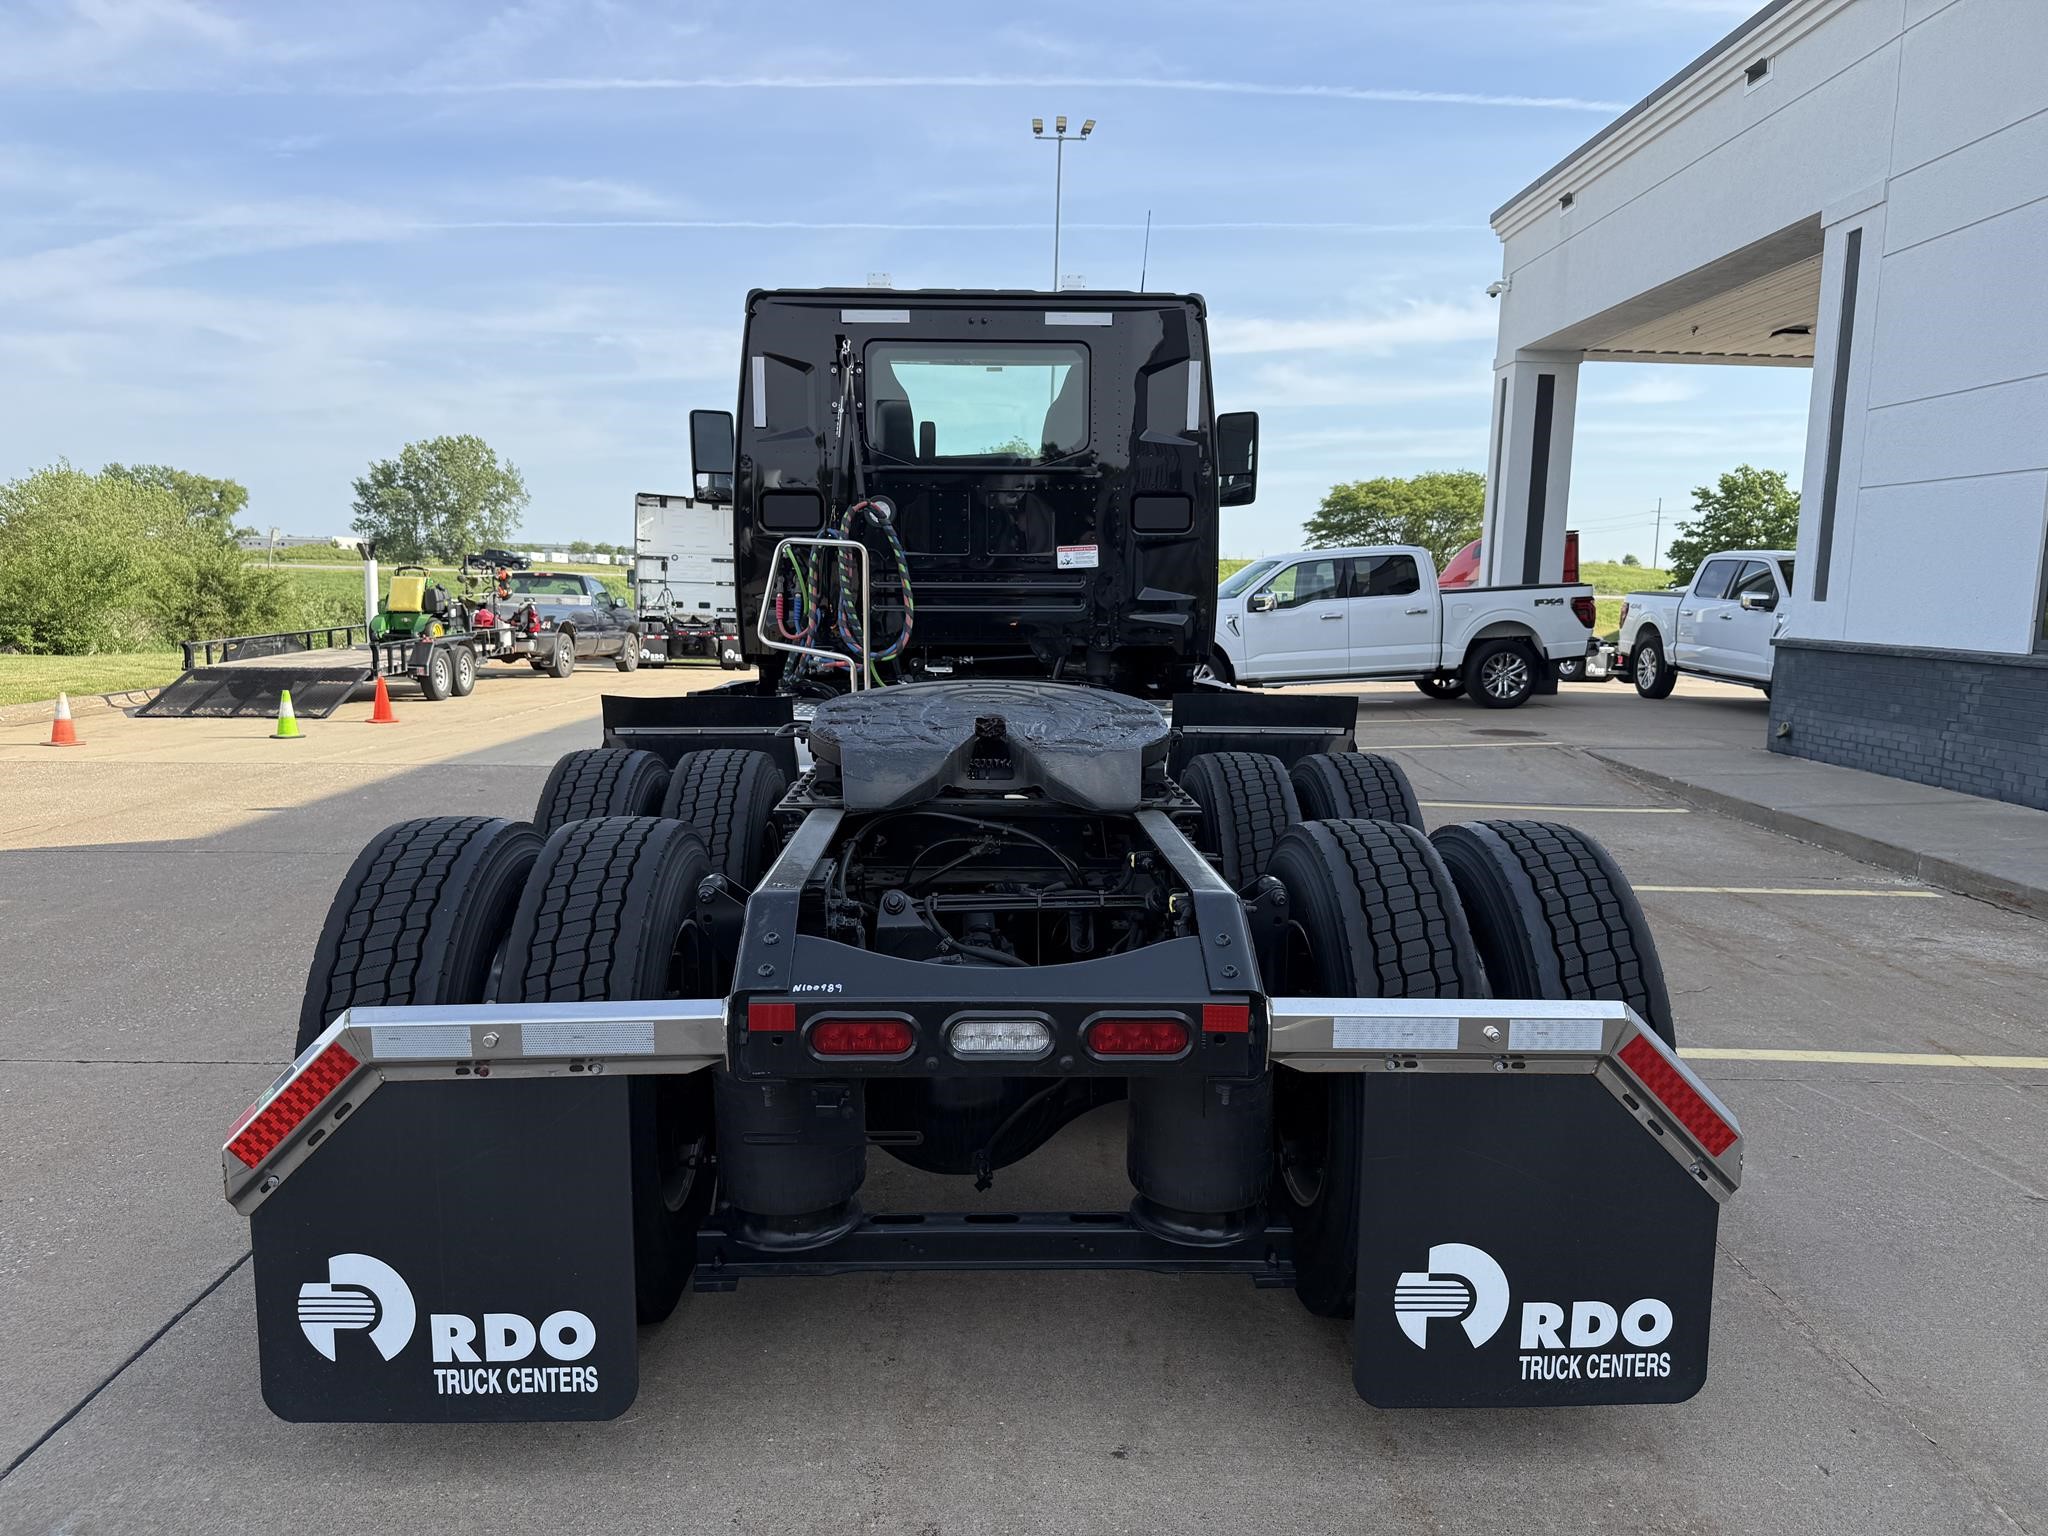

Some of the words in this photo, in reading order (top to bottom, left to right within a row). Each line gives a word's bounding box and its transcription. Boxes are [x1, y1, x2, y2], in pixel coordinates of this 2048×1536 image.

[1534, 598, 1564, 607] FX4
[430, 1310, 596, 1362] RDO
[1520, 1298, 1673, 1349] RDO
[433, 1368, 503, 1395] TRUCK
[506, 1366, 599, 1394] CENTERS
[1519, 1354, 1582, 1380] TRUCK
[1586, 1352, 1671, 1379] CENTERS
